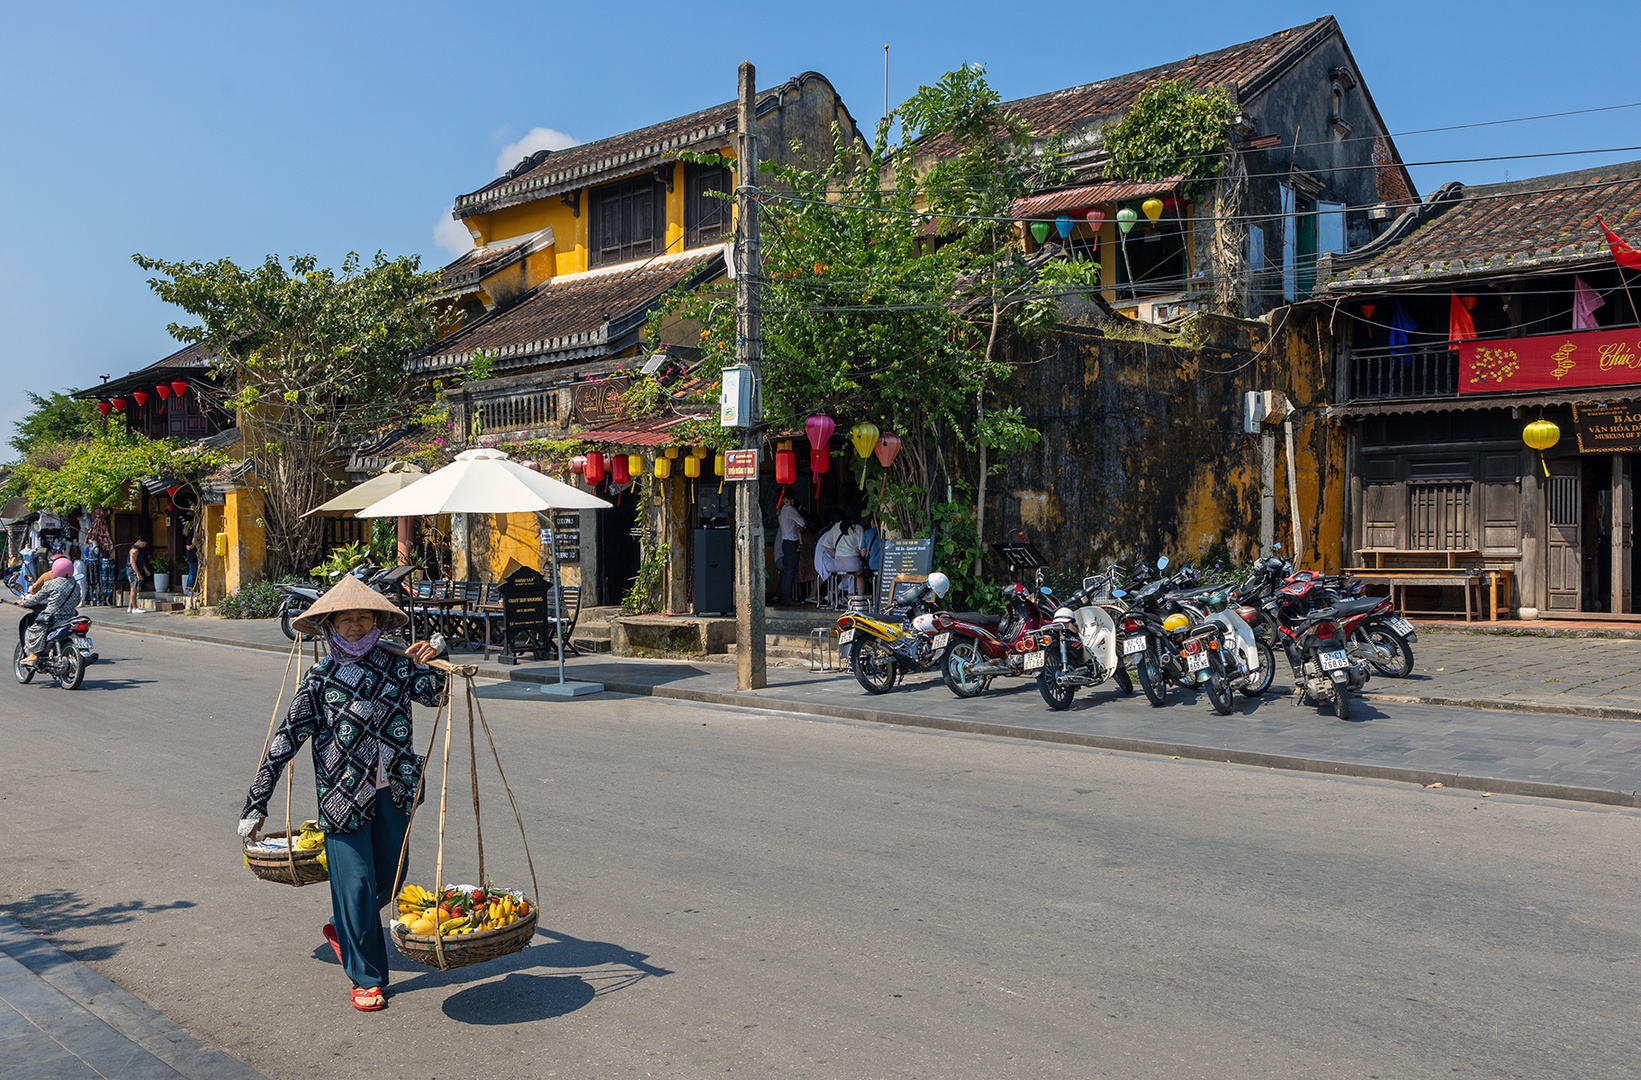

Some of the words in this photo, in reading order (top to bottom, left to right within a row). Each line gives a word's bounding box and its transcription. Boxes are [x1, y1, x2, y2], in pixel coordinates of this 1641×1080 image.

[1614, 411, 1641, 423] BẢO
[1589, 425, 1608, 433] VĂN
[1610, 423, 1630, 432] HÓA
[1323, 651, 1343, 661] 92-C1
[1323, 659, 1348, 670] 268.05
